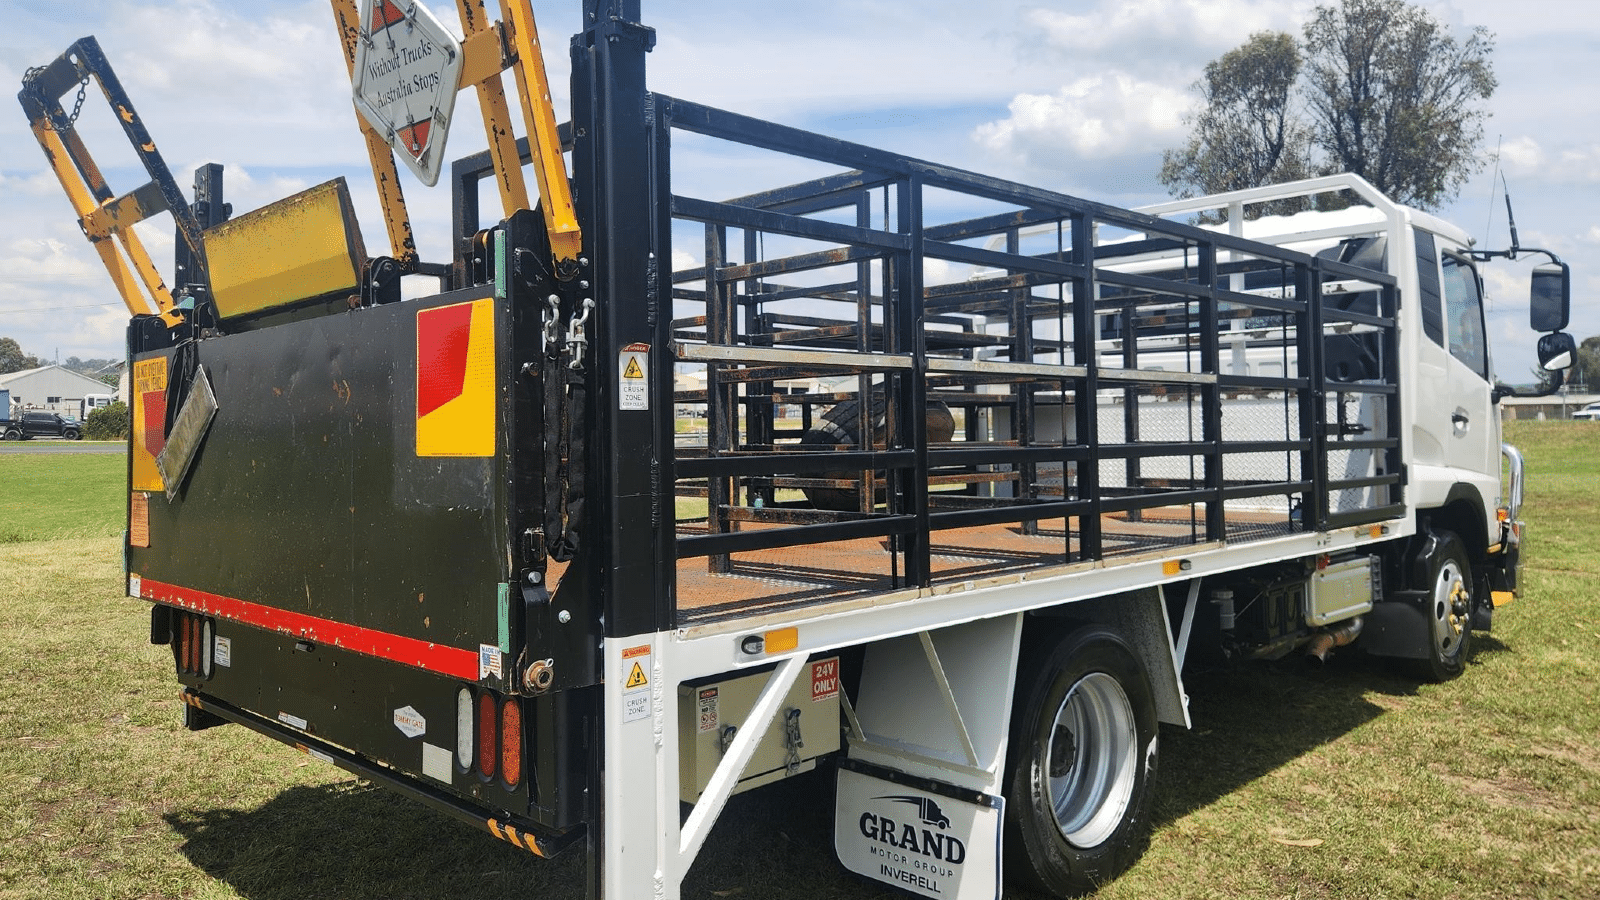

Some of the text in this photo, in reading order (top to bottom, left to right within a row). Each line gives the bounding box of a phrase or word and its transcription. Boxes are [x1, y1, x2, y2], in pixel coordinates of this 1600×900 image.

[369, 39, 432, 81] Without Trucks
[377, 71, 439, 109] Australia Stops
[816, 662, 834, 678] 24V
[814, 677, 836, 694] ONLY
[626, 697, 647, 708] CRUSH
[412, 719, 424, 729] GATE
[860, 812, 966, 865] GRAND
[870, 846, 954, 878] MOTOR GROUP
[880, 864, 942, 894] INVERELL
